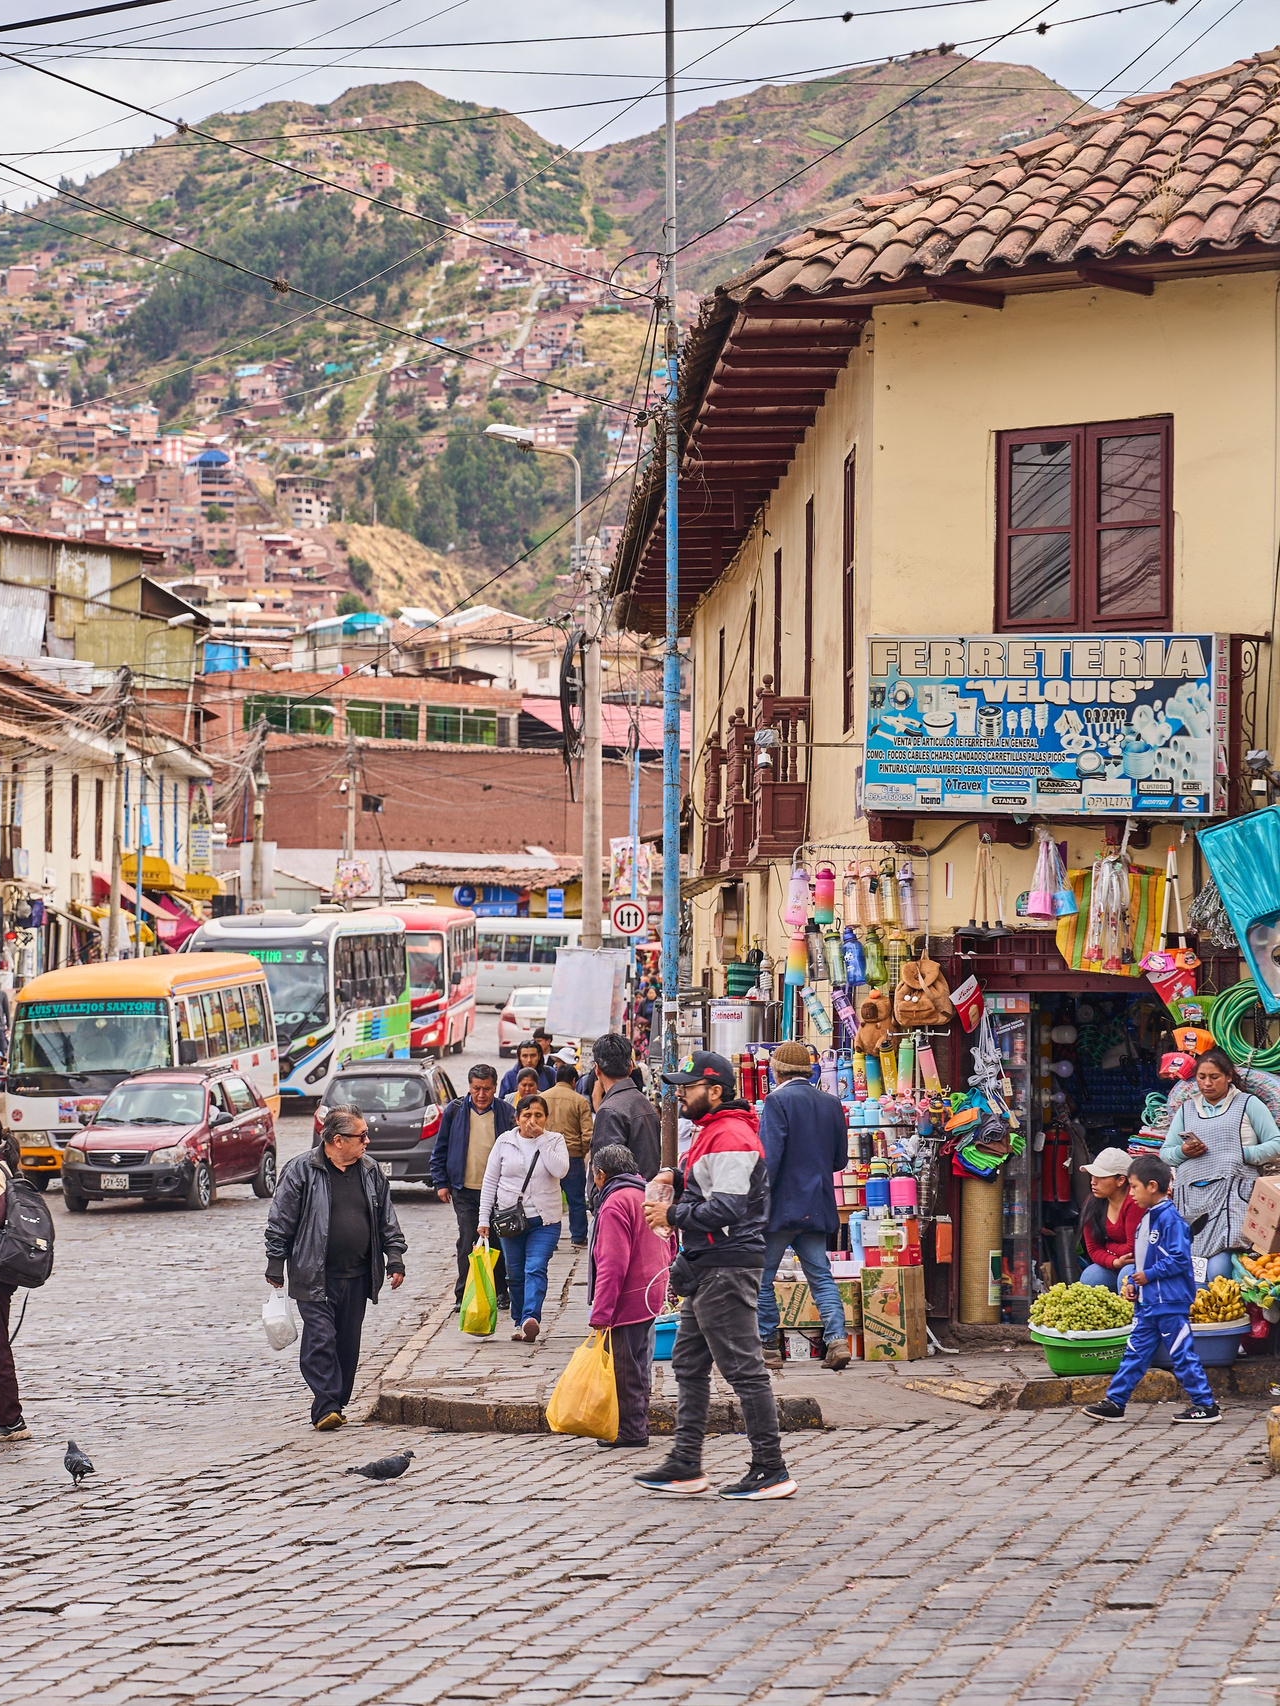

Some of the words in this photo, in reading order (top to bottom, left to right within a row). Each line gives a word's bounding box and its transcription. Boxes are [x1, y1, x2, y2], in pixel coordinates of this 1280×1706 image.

[870, 639, 1208, 679] FERRETERIA
[893, 737, 912, 746] VENTA
[913, 737, 921, 747] DE
[922, 737, 954, 747] ARTICULOS
[955, 738, 963, 747] DE
[964, 738, 1000, 748] FERRETERIA
[1001, 738, 1010, 748] EN
[1011, 738, 1038, 748] GENERAL
[866, 750, 885, 760] COMO:
[887, 750, 907, 760] FOCOS
[907, 751, 930, 760] CABLES
[930, 751, 954, 761] CHAPAS
[954, 751, 986, 761] CANDADOS
[987, 752, 1027, 761] CARRETILLAS
[1027, 752, 1046, 762] PALAS
[1047, 752, 1066, 762] PICOS
[878, 763, 907, 774] PINTURAS
[908, 764, 931, 774] CLAVOS
[931, 765, 962, 775] ALAMBRES
[963, 765, 982, 775] CERAS
[983, 766, 1022, 776] SILICONADAS
[1023, 766, 1028, 776] Y
[1029, 766, 1051, 776] OTROS.
[952, 778, 982, 791] Travex
[1087, 797, 1132, 807] OPALUX
[28, 1005, 51, 1015] LUIS
[53, 1003, 104, 1014] VALLEJOS
[106, 1002, 156, 1011] SANTONI
